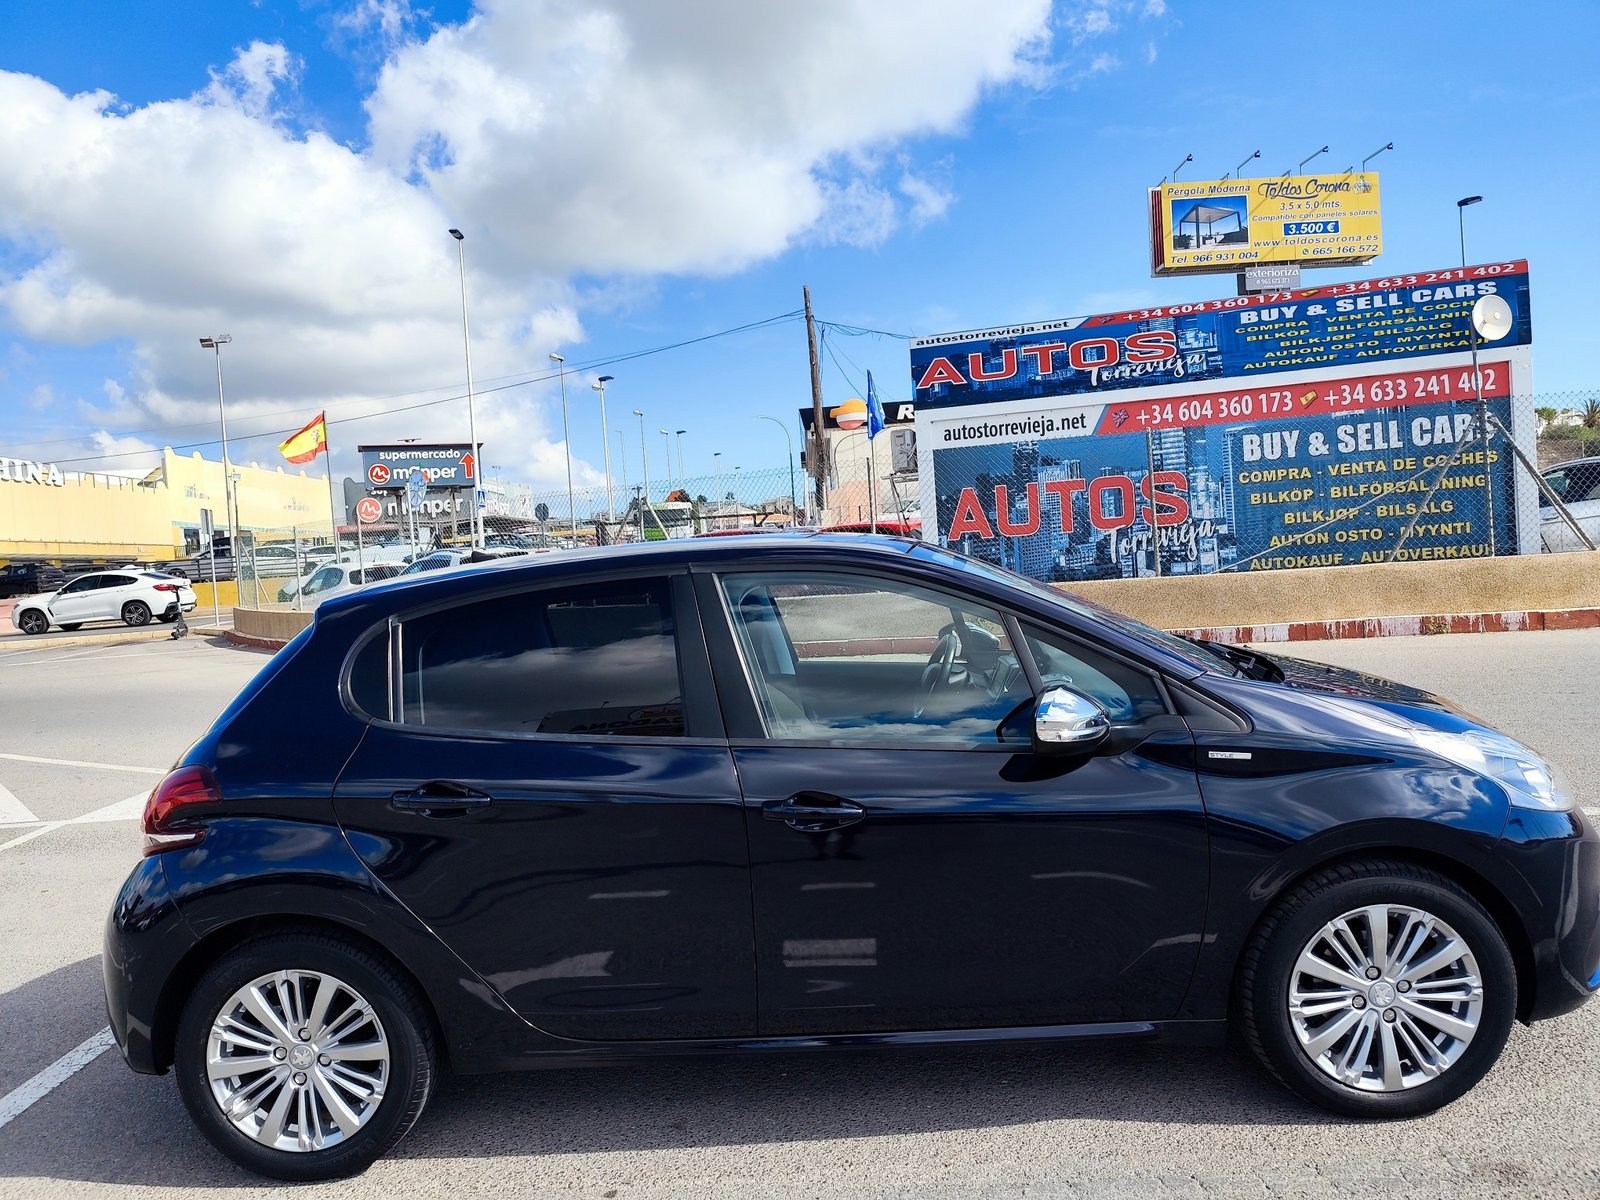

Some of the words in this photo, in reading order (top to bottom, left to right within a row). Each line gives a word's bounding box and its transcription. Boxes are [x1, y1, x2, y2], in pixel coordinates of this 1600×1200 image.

[1208, 184, 1251, 194] Moderna
[1258, 182, 1302, 199] Toldos
[1305, 179, 1351, 195] Corona
[1252, 211, 1297, 222] Compatible
[1316, 209, 1347, 220] paneles
[1349, 208, 1378, 216] solares
[1322, 200, 1342, 209] mts.
[1288, 223, 1324, 235] 3.500
[1327, 222, 1336, 233] €
[1253, 234, 1379, 247] www.toldoscorona.es
[1312, 247, 1333, 256] 665
[1337, 245, 1356, 254] 166
[1358, 244, 1379, 253] 572
[1171, 256, 1189, 264] Tel.
[1192, 254, 1213, 263] 966
[1215, 252, 1235, 261] 931
[1238, 251, 1259, 260] 004
[1246, 267, 1300, 279] exterioriza
[1327, 280, 1371, 295] +34
[1377, 275, 1417, 288] 633
[1425, 270, 1464, 282] 241
[1473, 263, 1515, 276] 402
[1123, 308, 1164, 321] +34
[1169, 302, 1206, 315] 604
[1212, 297, 1249, 310] 360
[1257, 292, 1293, 304] 173
[1240, 305, 1299, 325] BUY
[1306, 304, 1328, 316] &
[1335, 293, 1403, 312] SELL
[1411, 281, 1497, 303] CARS
[1235, 320, 1309, 334] COMPRA
[1326, 311, 1385, 322] VENTA
[1392, 306, 1416, 315] DE
[1422, 300, 1476, 312] COCH
[1246, 329, 1310, 342] BILKÖP
[1327, 310, 1470, 333] BILFÖRSÄLJNIN
[916, 320, 1070, 347] autostorrevieja.net
[1264, 346, 1325, 358] AUTON
[1331, 340, 1379, 350] OSTO
[1397, 330, 1470, 343] MYYNTI
[1280, 333, 1356, 347] BILKJØP
[1373, 322, 1453, 337] BILSALG
[916, 331, 1178, 390] AUTOS
[1085, 353, 1206, 387] Torrevieja
[1243, 353, 1339, 369] AUTOKAUF
[1324, 383, 1366, 407] +34
[1370, 377, 1407, 402] 633
[1413, 373, 1450, 397] 241
[1458, 368, 1496, 393] 402
[1136, 403, 1174, 426] +34
[1178, 399, 1213, 422] 604
[1218, 394, 1253, 418] 360
[1258, 390, 1293, 414] 173
[943, 412, 1087, 442] autostorrevieja.net
[1243, 429, 1301, 462] BUY
[1308, 431, 1330, 457] &
[1337, 420, 1404, 454] SELL
[379, 449, 461, 462] supermercado
[1239, 466, 1312, 484] COMPRA
[1327, 460, 1387, 477] VENTA
[1393, 457, 1417, 471] DE
[387, 497, 464, 518] mnper
[949, 471, 1190, 541] AUTOS
[1250, 487, 1314, 505] BILKÖP
[1376, 500, 1454, 519] BILSALG
[1270, 532, 1329, 548] AUTON
[1335, 528, 1383, 542] OSTO
[1250, 553, 1344, 571] AUTOKAUF
